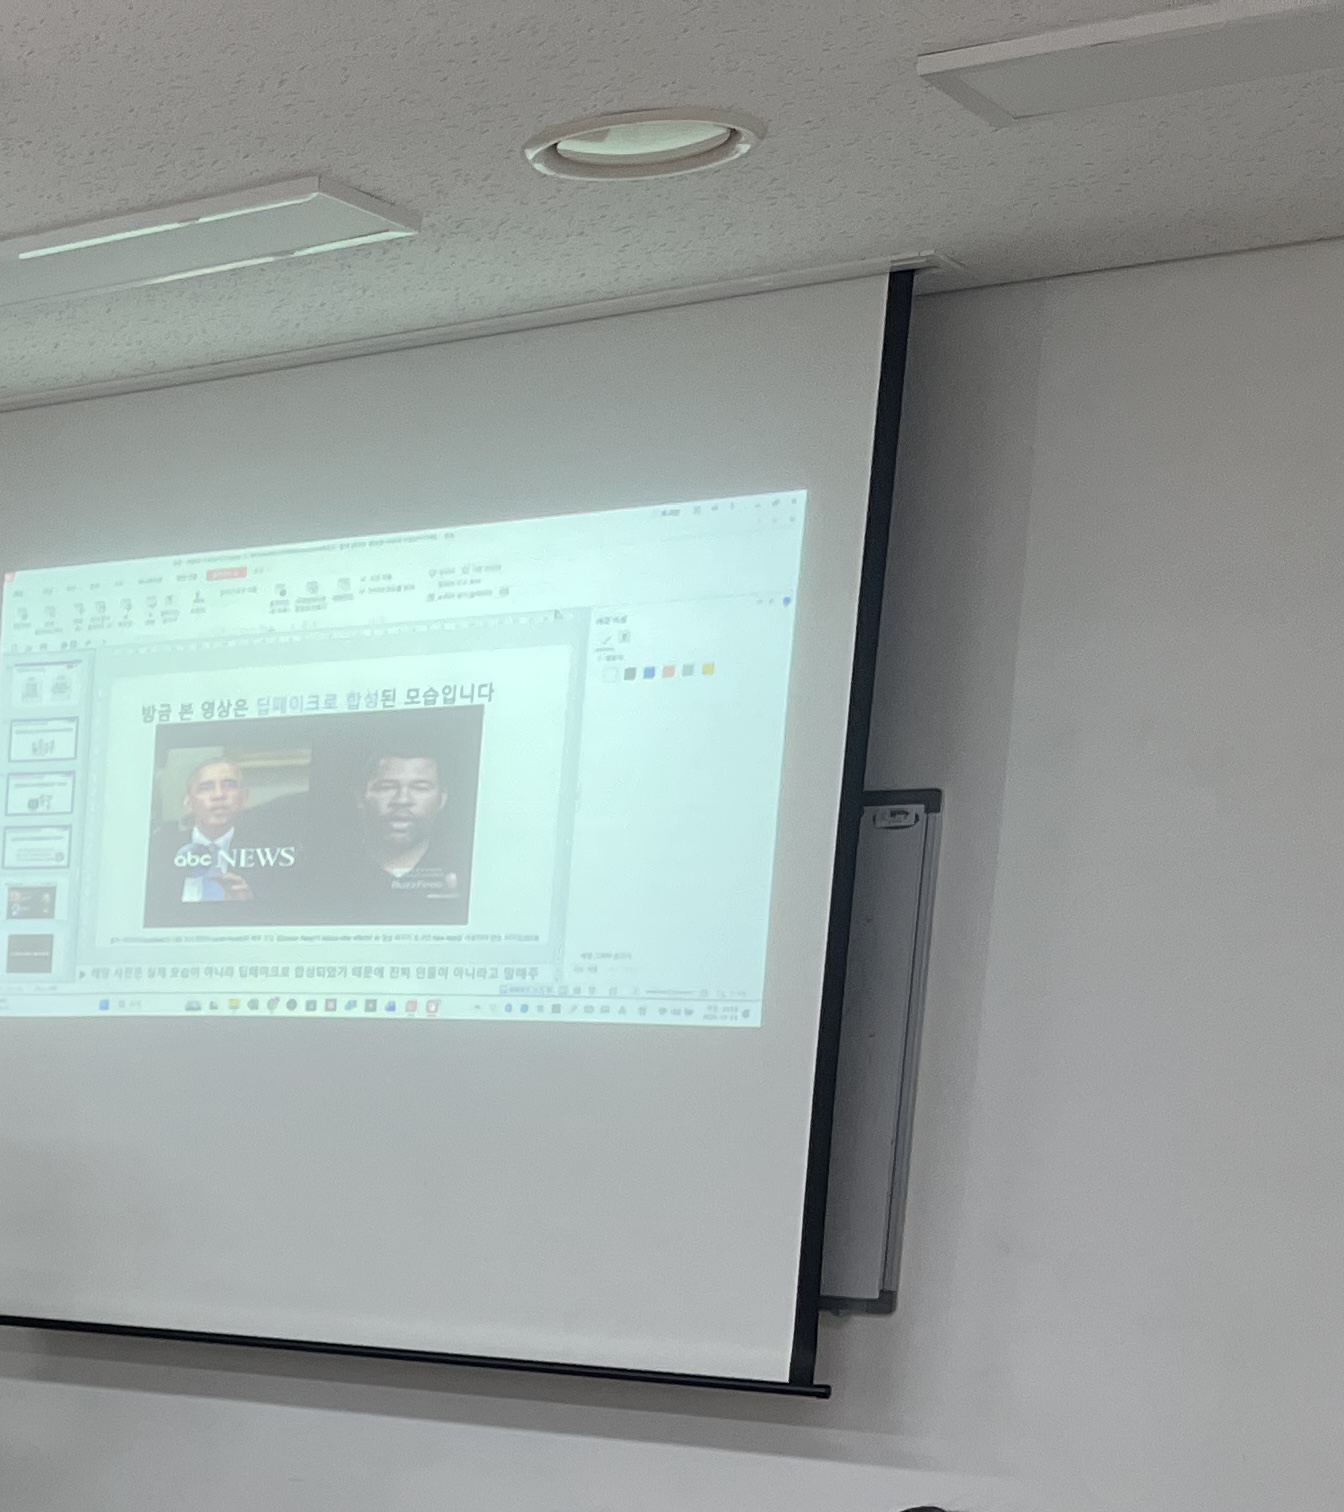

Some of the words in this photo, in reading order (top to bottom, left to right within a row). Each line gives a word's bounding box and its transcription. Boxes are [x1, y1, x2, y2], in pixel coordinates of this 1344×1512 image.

[141, 703, 173, 724] 방금
[178, 703, 194, 720] 본
[201, 698, 249, 720] 영상은
[255, 692, 339, 716] 딥페이크로
[345, 688, 397, 711] 합성된
[404, 681, 495, 706] 모습입니다
[173, 852, 213, 868] abc
[216, 846, 296, 869] NEWS
